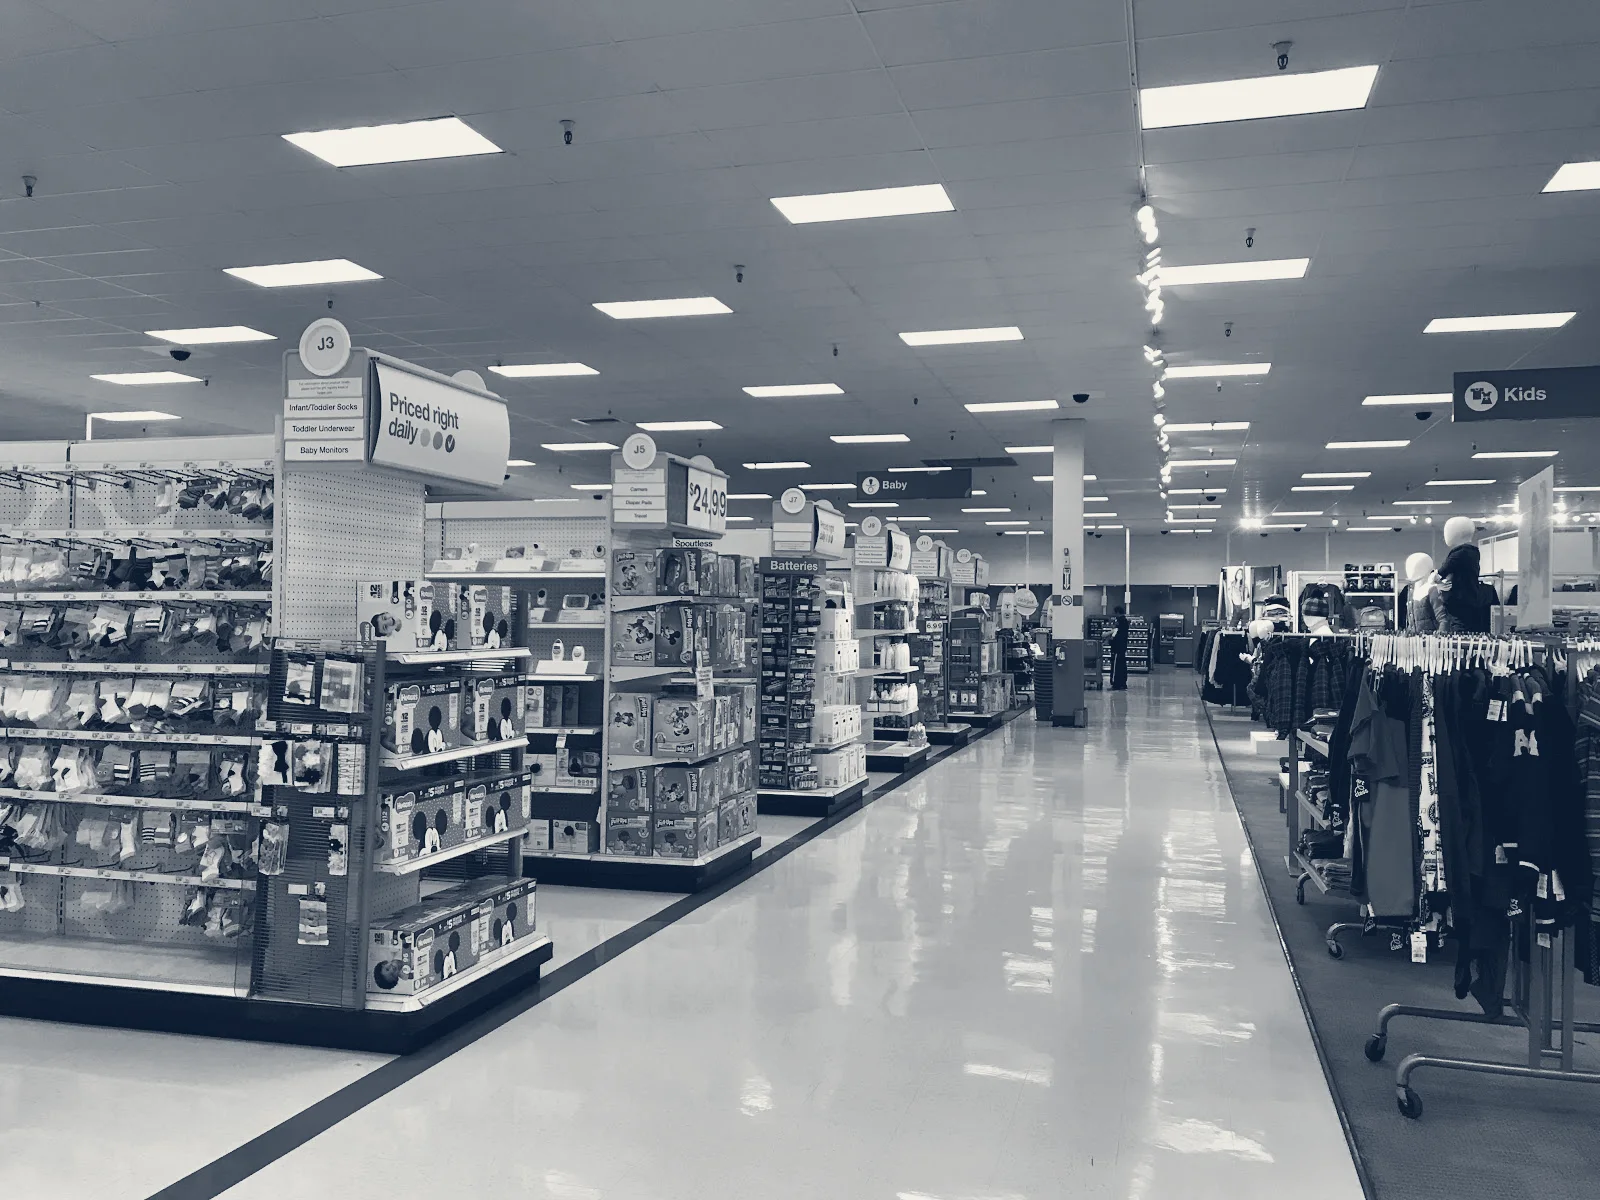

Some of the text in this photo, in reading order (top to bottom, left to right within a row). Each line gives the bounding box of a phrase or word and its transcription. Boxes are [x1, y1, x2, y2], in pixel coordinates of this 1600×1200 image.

[317, 336, 334, 351] J3
[1504, 387, 1546, 402] Kids
[390, 392, 459, 430] Priced right
[388, 417, 418, 445] daily
[300, 447, 317, 455] Baby
[634, 445, 645, 454] J5
[882, 480, 907, 491] Baby
[690, 482, 726, 518] $24.99
[675, 539, 713, 548] Spoutless
[770, 560, 818, 572] Batteries
